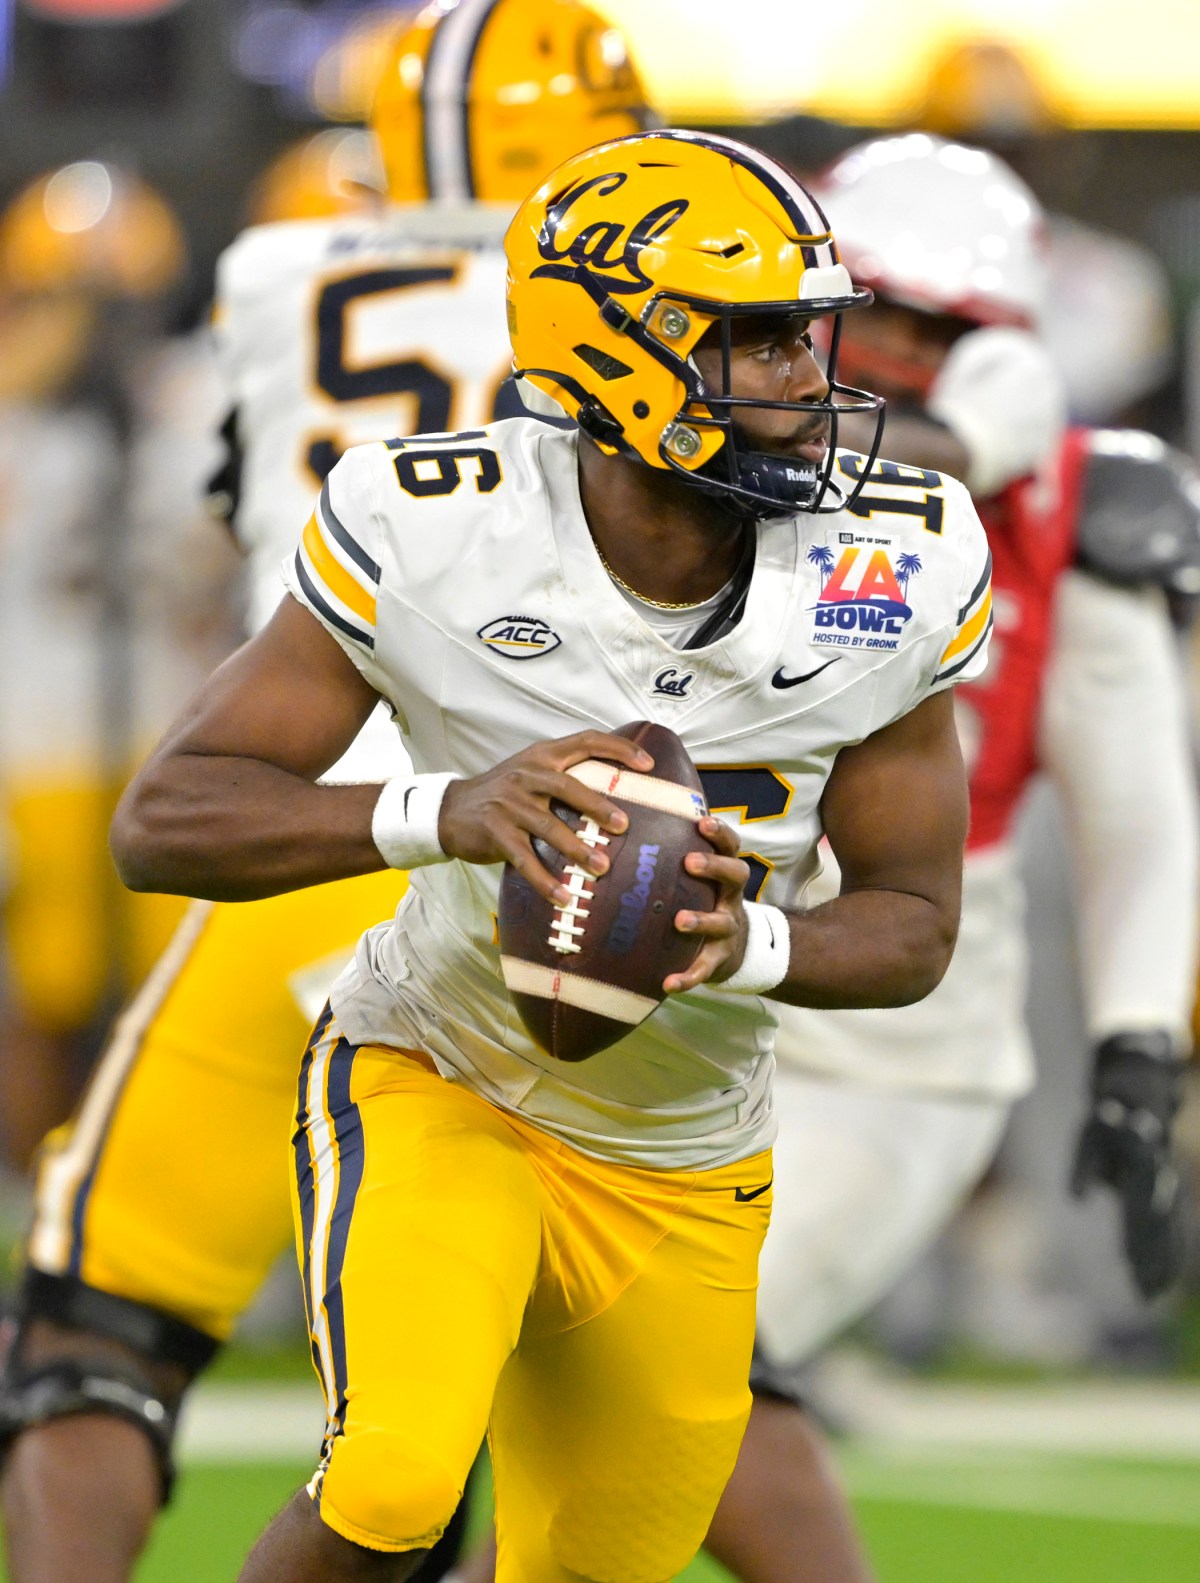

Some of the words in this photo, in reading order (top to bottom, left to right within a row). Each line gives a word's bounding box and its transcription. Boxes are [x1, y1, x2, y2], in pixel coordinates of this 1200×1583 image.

[530, 172, 690, 294] Cal
[382, 430, 503, 499] 16
[836, 454, 944, 537] 16
[818, 547, 905, 604] LA
[491, 626, 550, 645] ACC
[813, 633, 850, 645] HOSTED
[851, 636, 865, 645] BY
[866, 638, 899, 649] GRONK
[814, 602, 903, 635] BOWL
[653, 669, 693, 697] Cal
